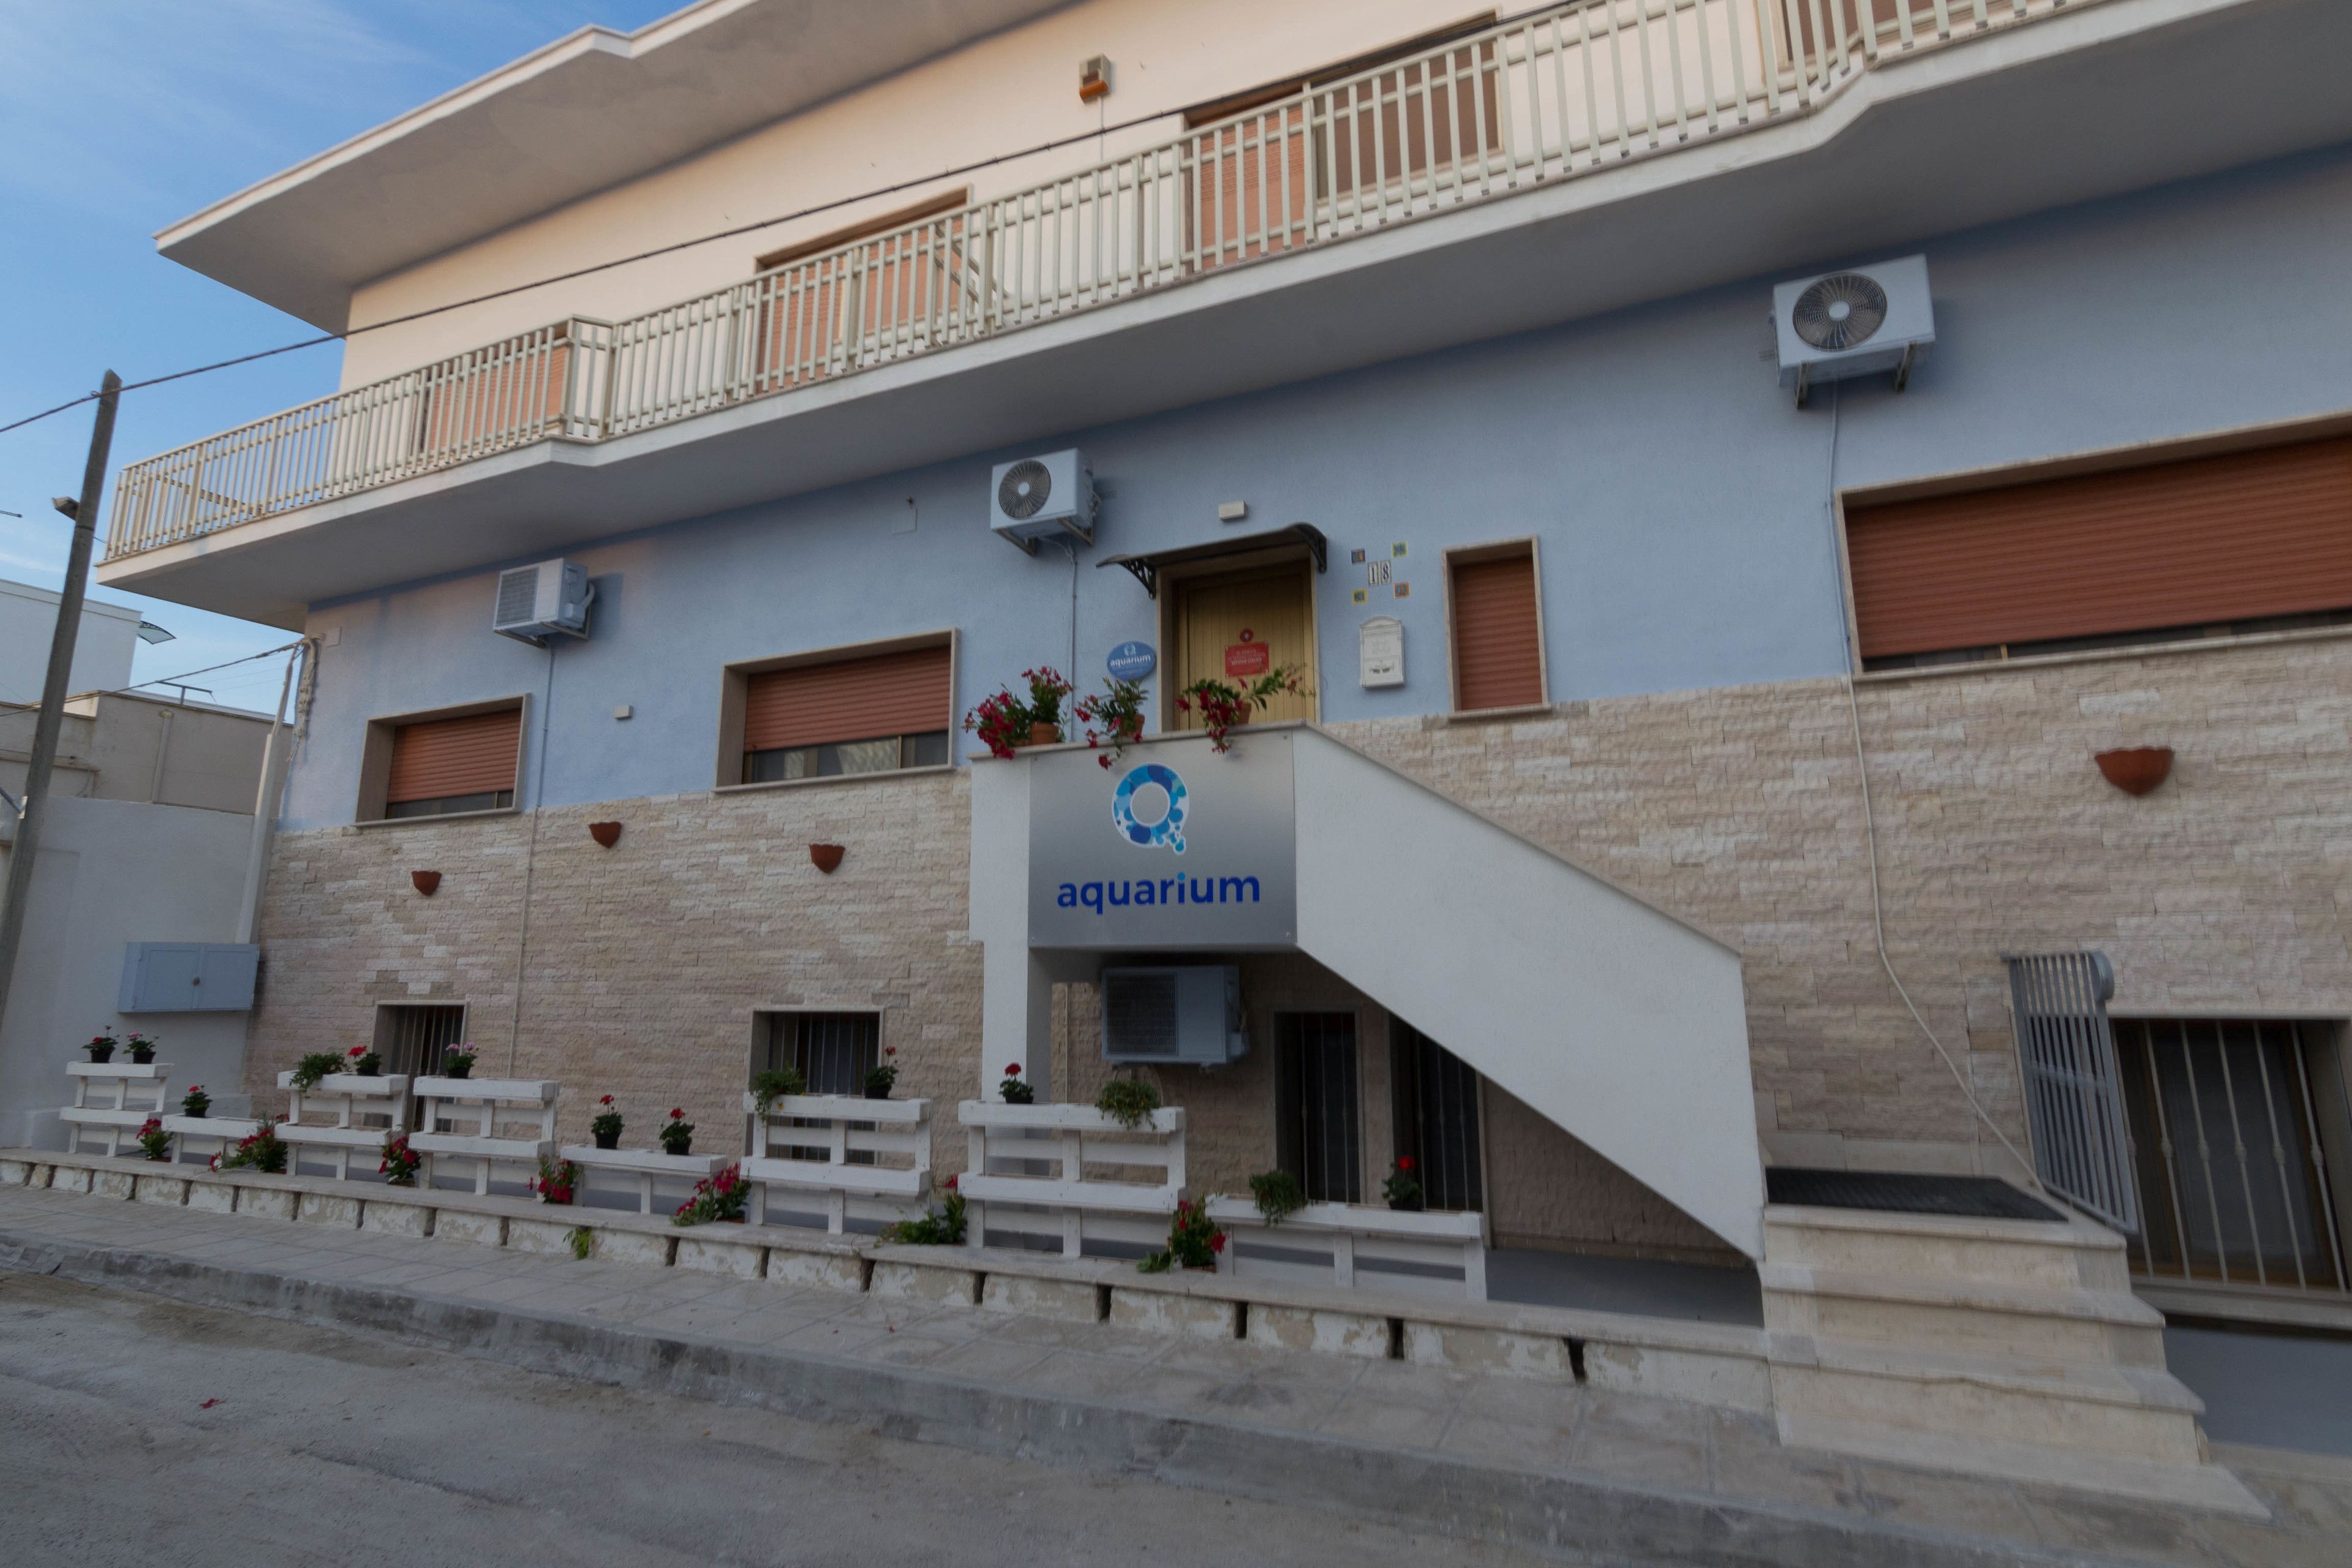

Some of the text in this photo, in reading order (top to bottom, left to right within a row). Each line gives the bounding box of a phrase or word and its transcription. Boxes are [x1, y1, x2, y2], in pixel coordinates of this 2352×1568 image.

[1371, 564, 1390, 583] 18
[1110, 654, 1151, 668] aquarium
[1057, 872, 1261, 915] aquarium
